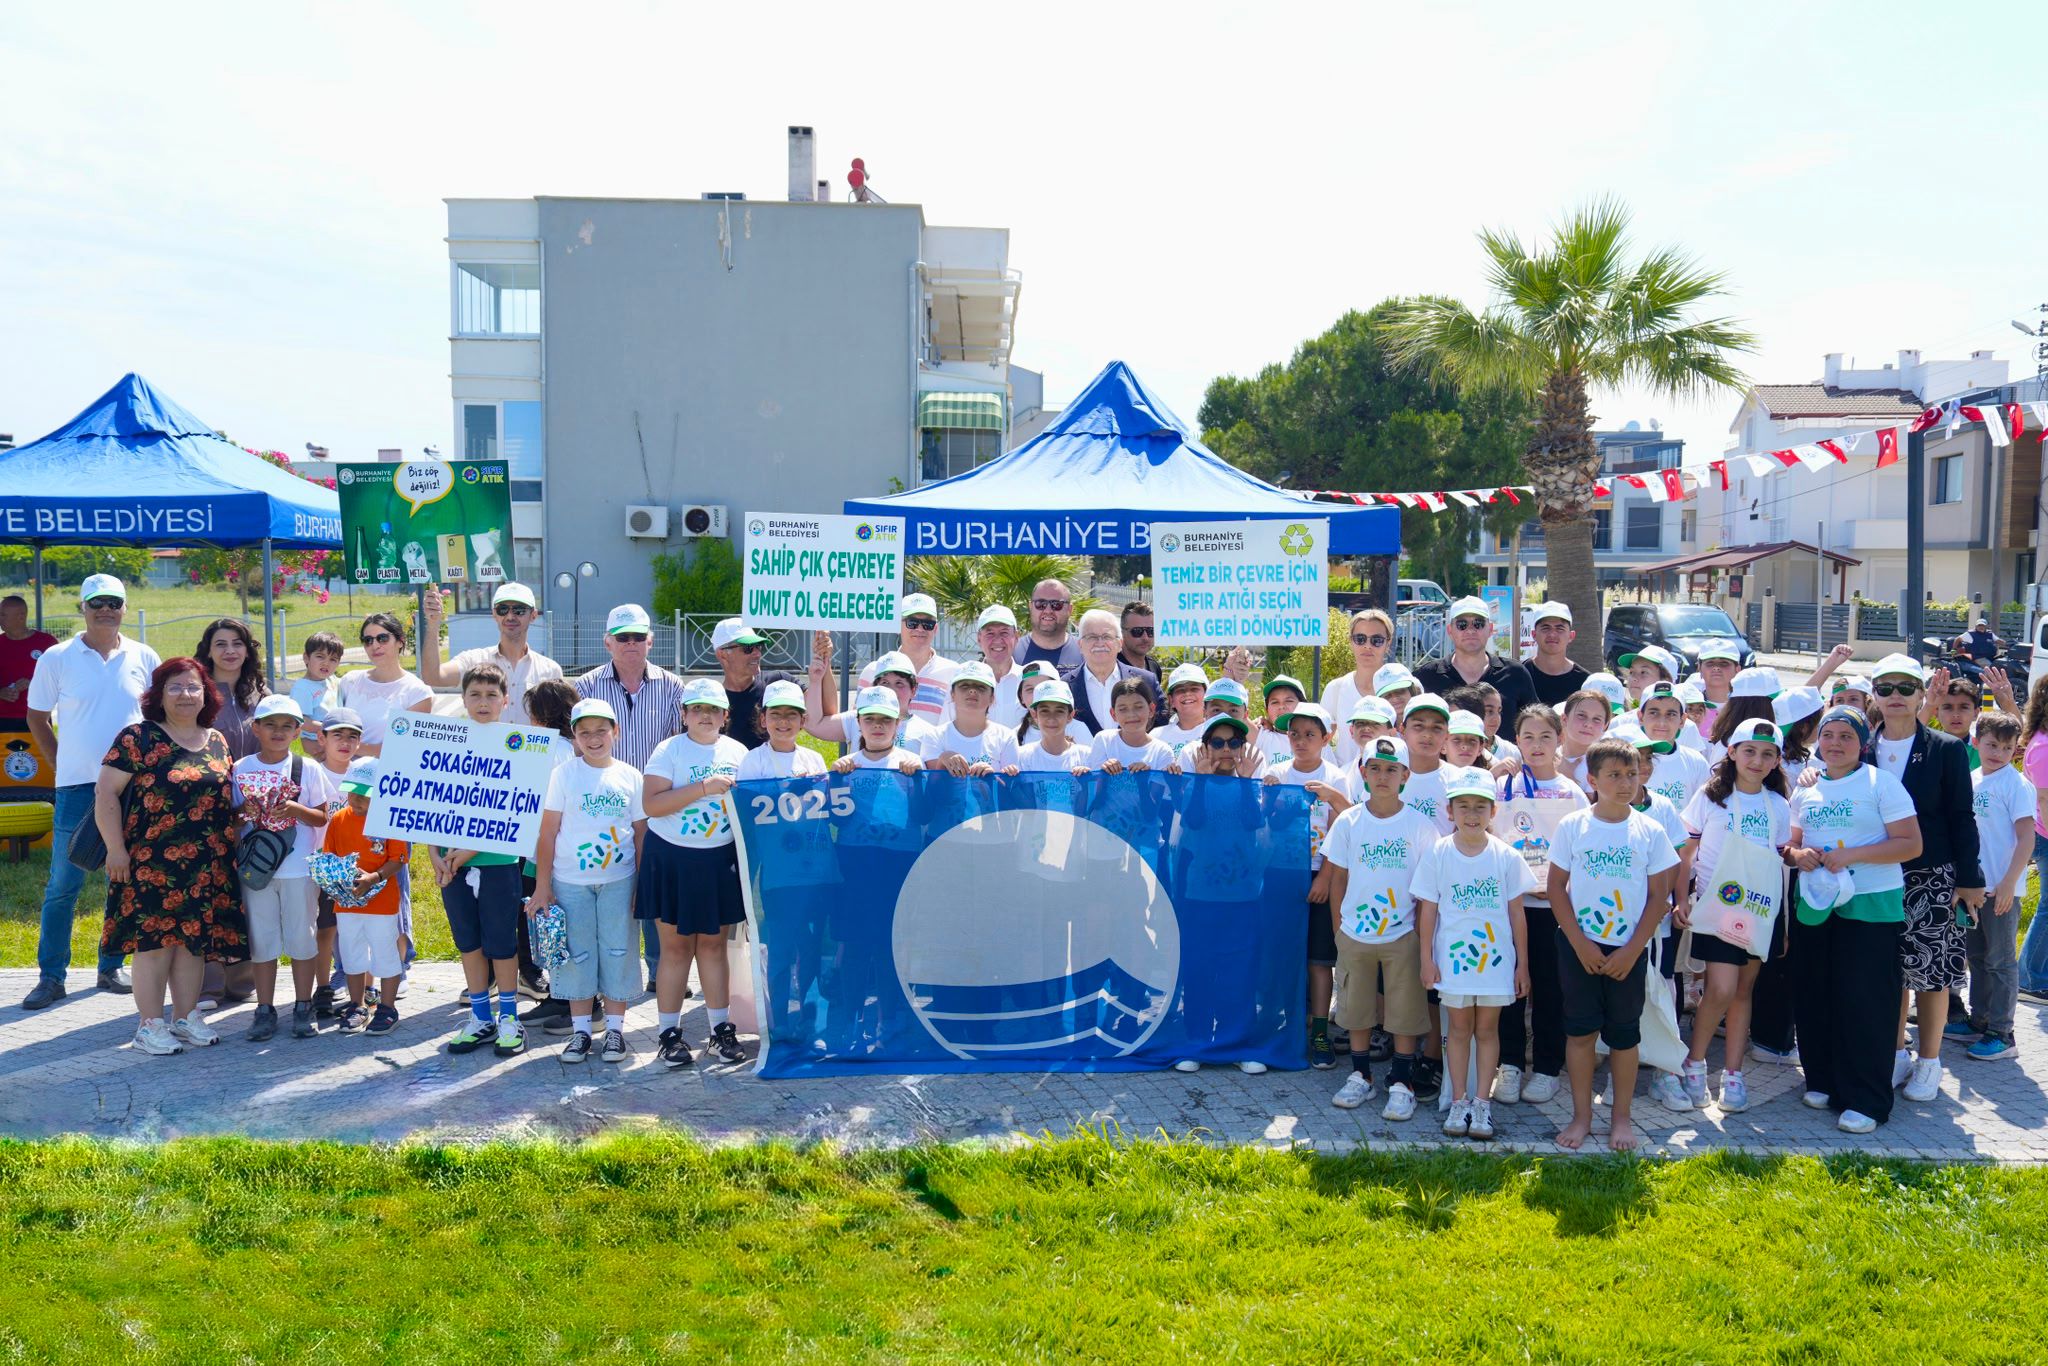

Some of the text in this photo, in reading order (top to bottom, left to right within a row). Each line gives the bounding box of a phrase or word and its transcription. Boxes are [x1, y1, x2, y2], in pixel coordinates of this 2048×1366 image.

[408, 466, 422, 478] Biz
[481, 466, 504, 475] SIFIR
[410, 479, 440, 493] değiliz!
[482, 474, 504, 484] ATIK
[35, 504, 213, 532] BELEDİYESİ
[769, 520, 818, 529] BURHANİYE
[769, 530, 820, 538] BELEDİYESİ
[876, 524, 898, 533] SIFIR
[916, 516, 1118, 549] BURHANİYE
[876, 532, 896, 542] ATIK
[1184, 531, 1243, 542] BURHANİYE
[1184, 541, 1244, 552] BELEDİYESİ
[751, 544, 896, 582] SAHİP ÇIK ÇEVREYE
[356, 570, 368, 578] CAM
[410, 568, 427, 578] METAL
[481, 568, 502, 576] KARTON
[1161, 562, 1205, 584] TEMİZ
[1236, 564, 1284, 586] ÇEVRE
[1288, 560, 1318, 585] İÇİN
[749, 586, 894, 620] UMUT OL GELECEĞE
[1178, 587, 1302, 612] SIFIR ATIĞI SEÇİN
[1160, 613, 1321, 639] ATMA GERİ DÖNÜŞTÜR
[414, 720, 468, 734] BURHANİYE
[412, 729, 468, 744] BELEDİYESİ
[526, 734, 550, 745] SIFIR
[525, 744, 548, 754] ATIK
[420, 749, 511, 780] SOKAĞIMIZA
[378, 771, 541, 816] ÇÖP ATMADIĞINIZ İÇİN
[751, 786, 856, 824] 2025
[389, 806, 520, 843] TEŞEKKÜR EDERİZ
[1744, 900, 1770, 918] ATIK
